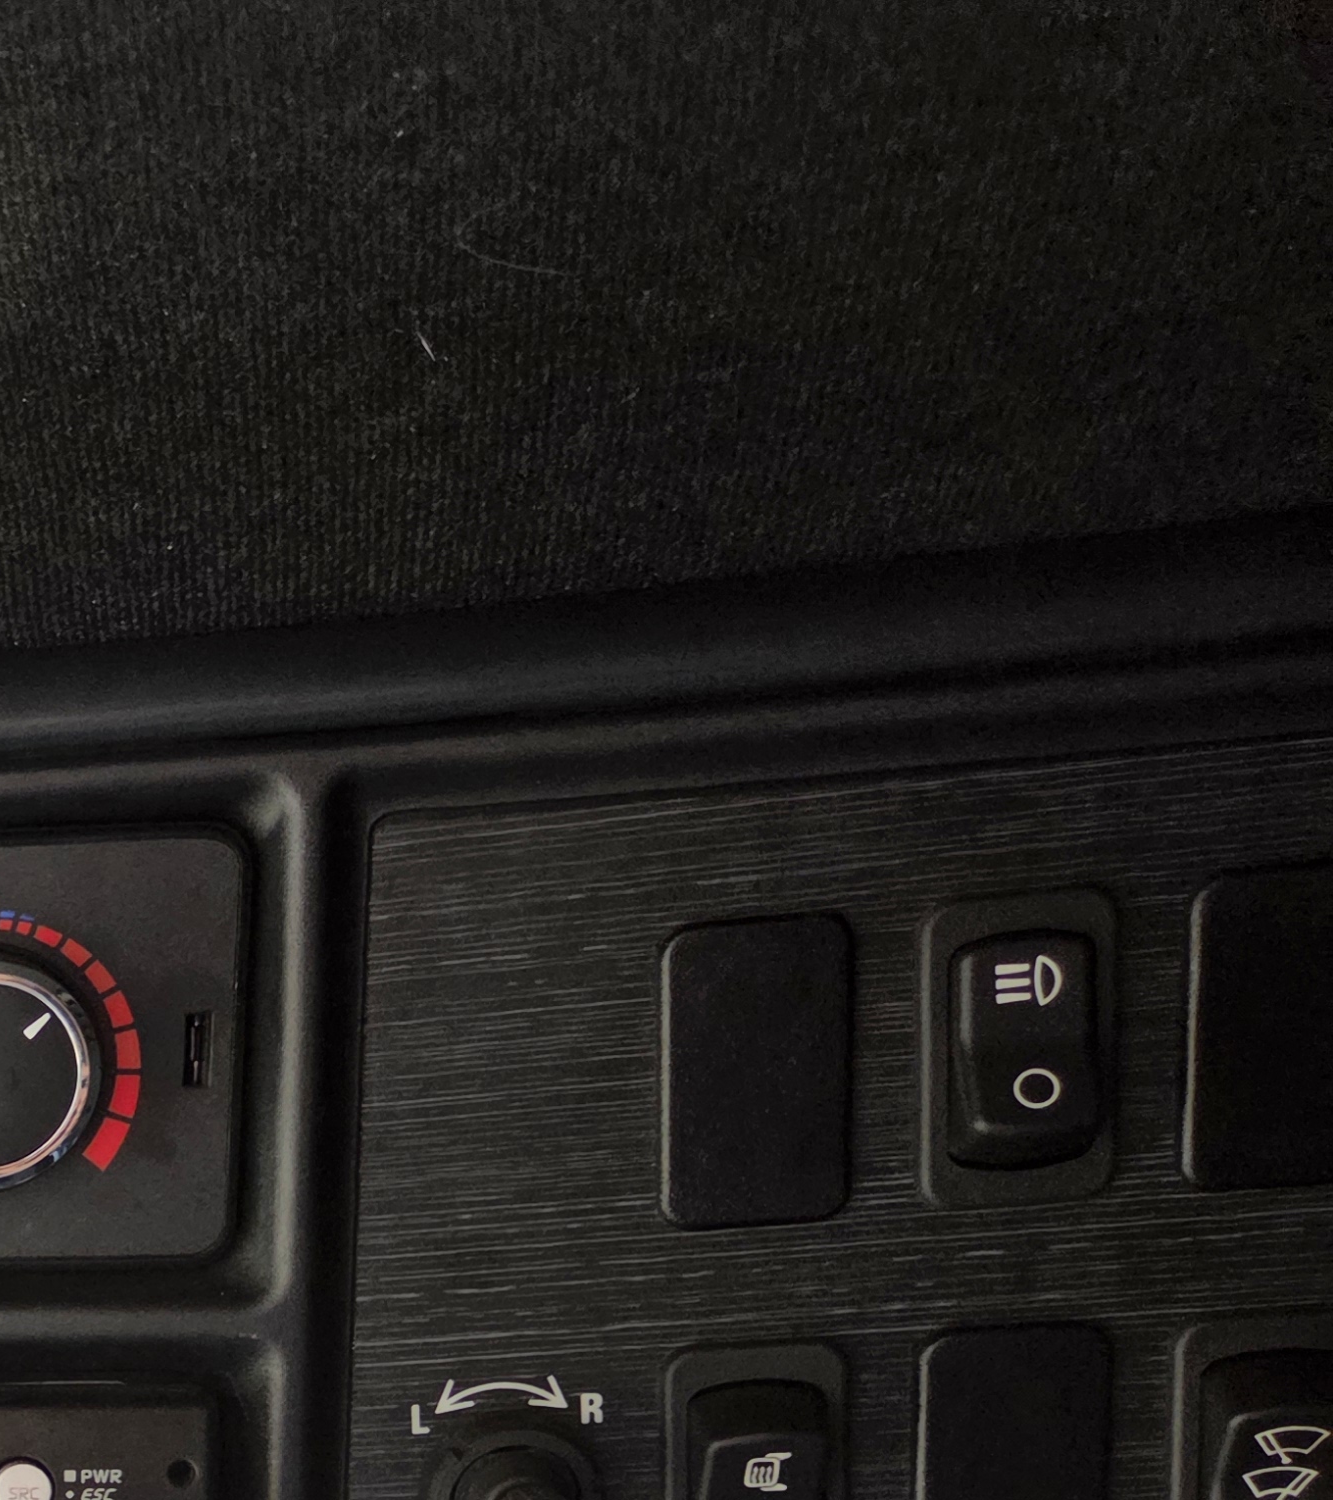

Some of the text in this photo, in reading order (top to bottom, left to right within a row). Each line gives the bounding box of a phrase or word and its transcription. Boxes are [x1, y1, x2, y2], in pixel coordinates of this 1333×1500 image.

[411, 1404, 430, 1435] L
[580, 1393, 603, 1424] R
[80, 1469, 122, 1484] PWR
[8, 1487, 39, 1500] SRC
